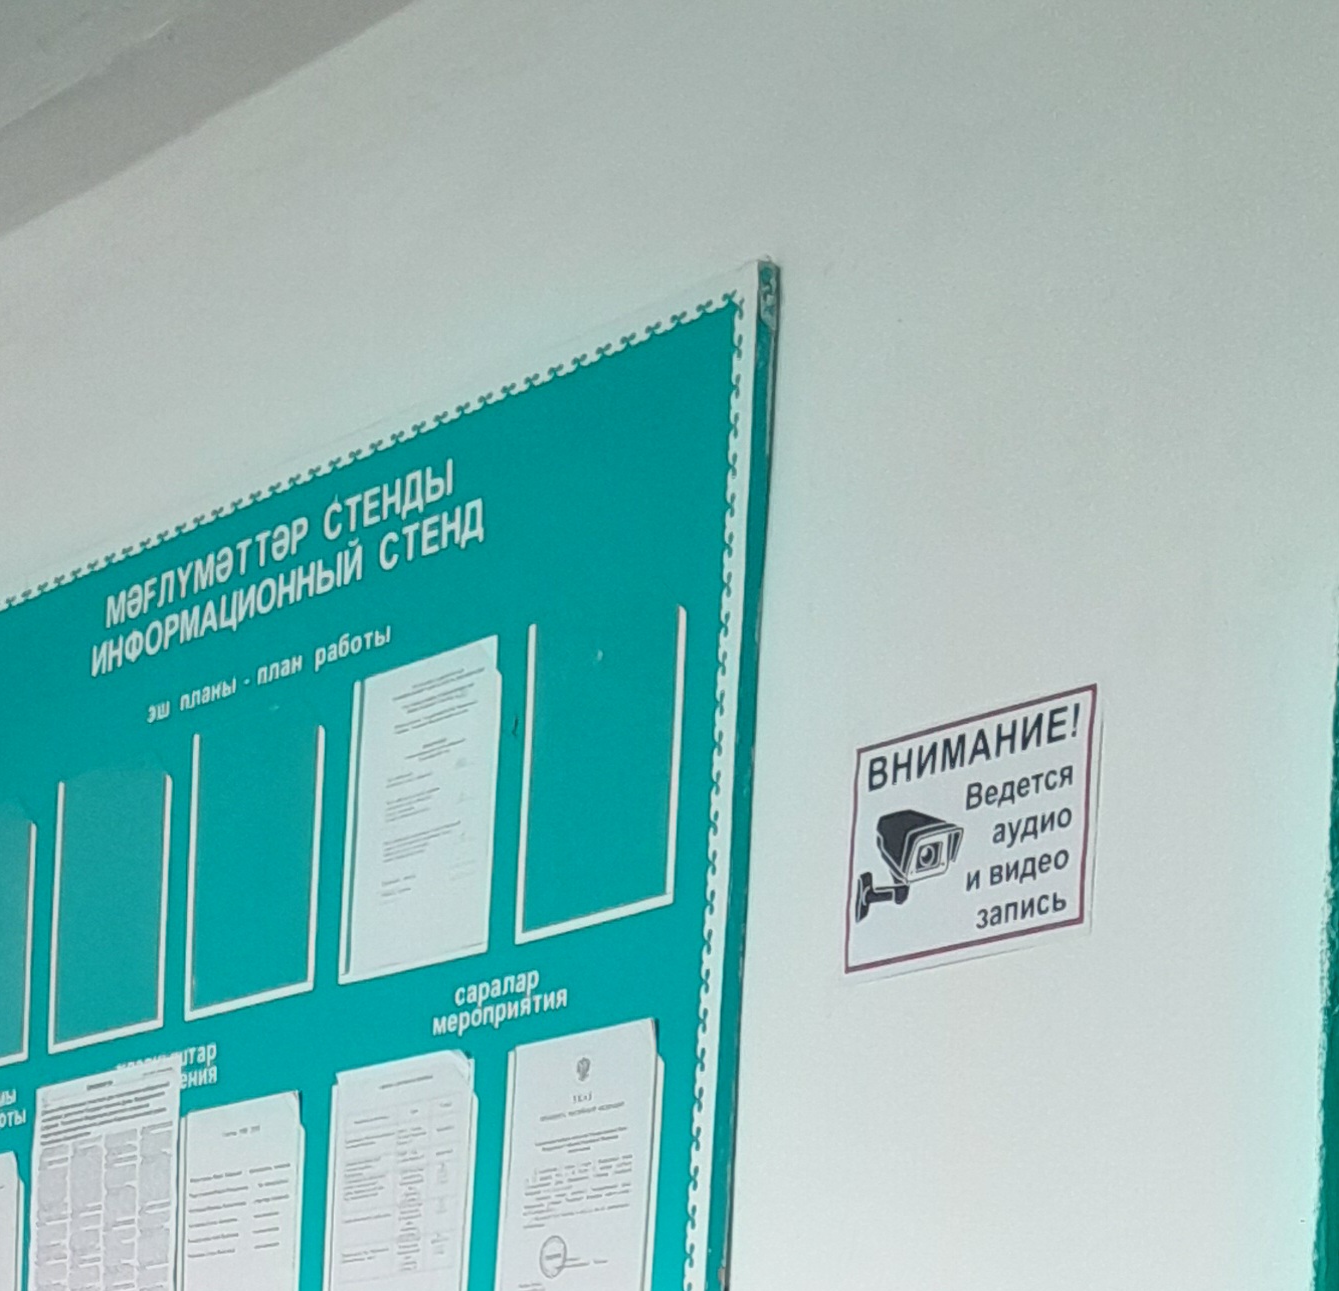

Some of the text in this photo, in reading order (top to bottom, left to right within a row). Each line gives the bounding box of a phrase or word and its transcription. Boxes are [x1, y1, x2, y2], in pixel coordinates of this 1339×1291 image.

[323, 458, 453, 541] СТЕНДЫ
[91, 498, 484, 678] ИНФОРМАЦИОННЫЙ СТЕНД
[146, 701, 170, 723] эш
[180, 677, 236, 712] планы
[257, 654, 303, 685] план
[314, 625, 391, 673] работы
[868, 703, 1080, 792] ВНИМАНИЕ!
[965, 765, 1074, 811] Ведется
[992, 807, 1072, 849] аудио
[965, 849, 1070, 892] и видео
[975, 891, 1067, 930] запись
[454, 970, 540, 1007] саралар
[432, 988, 568, 1037] мероприятия
